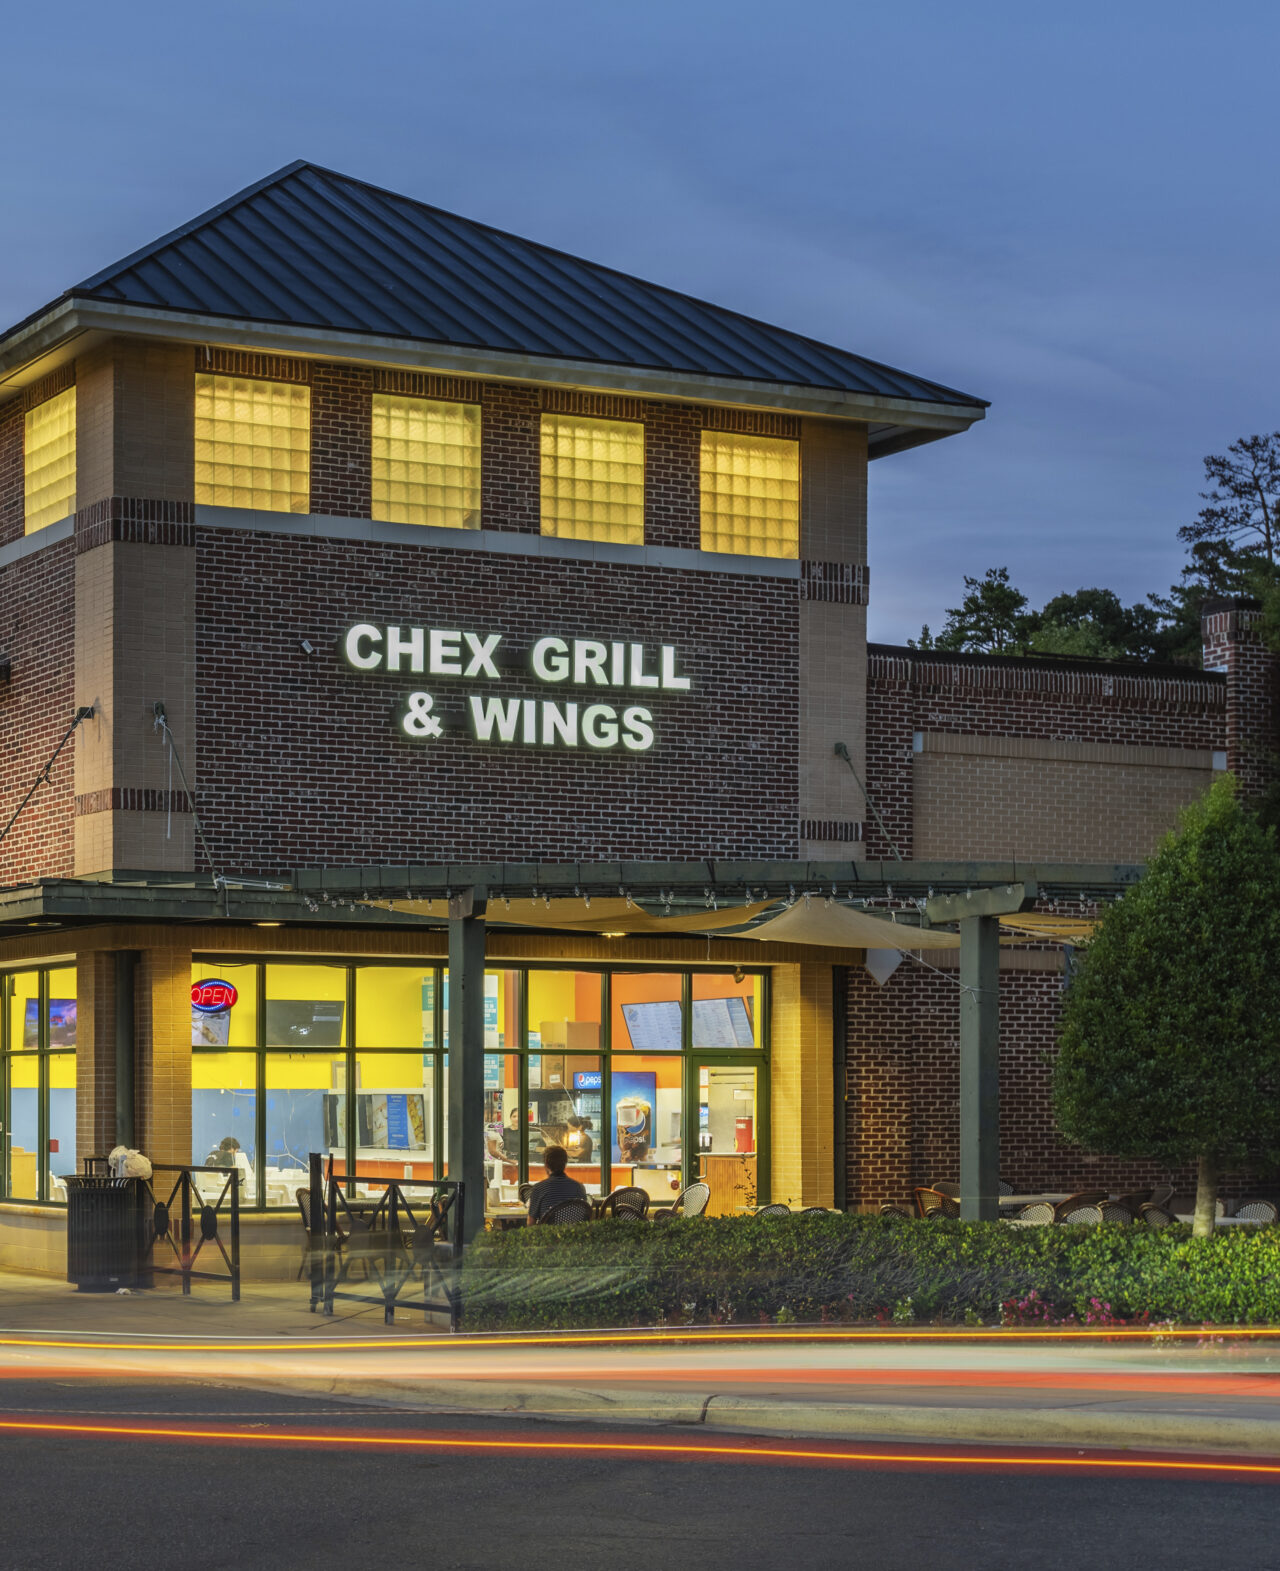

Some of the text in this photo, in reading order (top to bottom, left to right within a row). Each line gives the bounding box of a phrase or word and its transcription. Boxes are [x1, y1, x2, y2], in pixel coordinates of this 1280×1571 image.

[346, 624, 691, 690] CHEX GRILL
[403, 692, 655, 751] & WINGS
[191, 987, 235, 1004] OPEN
